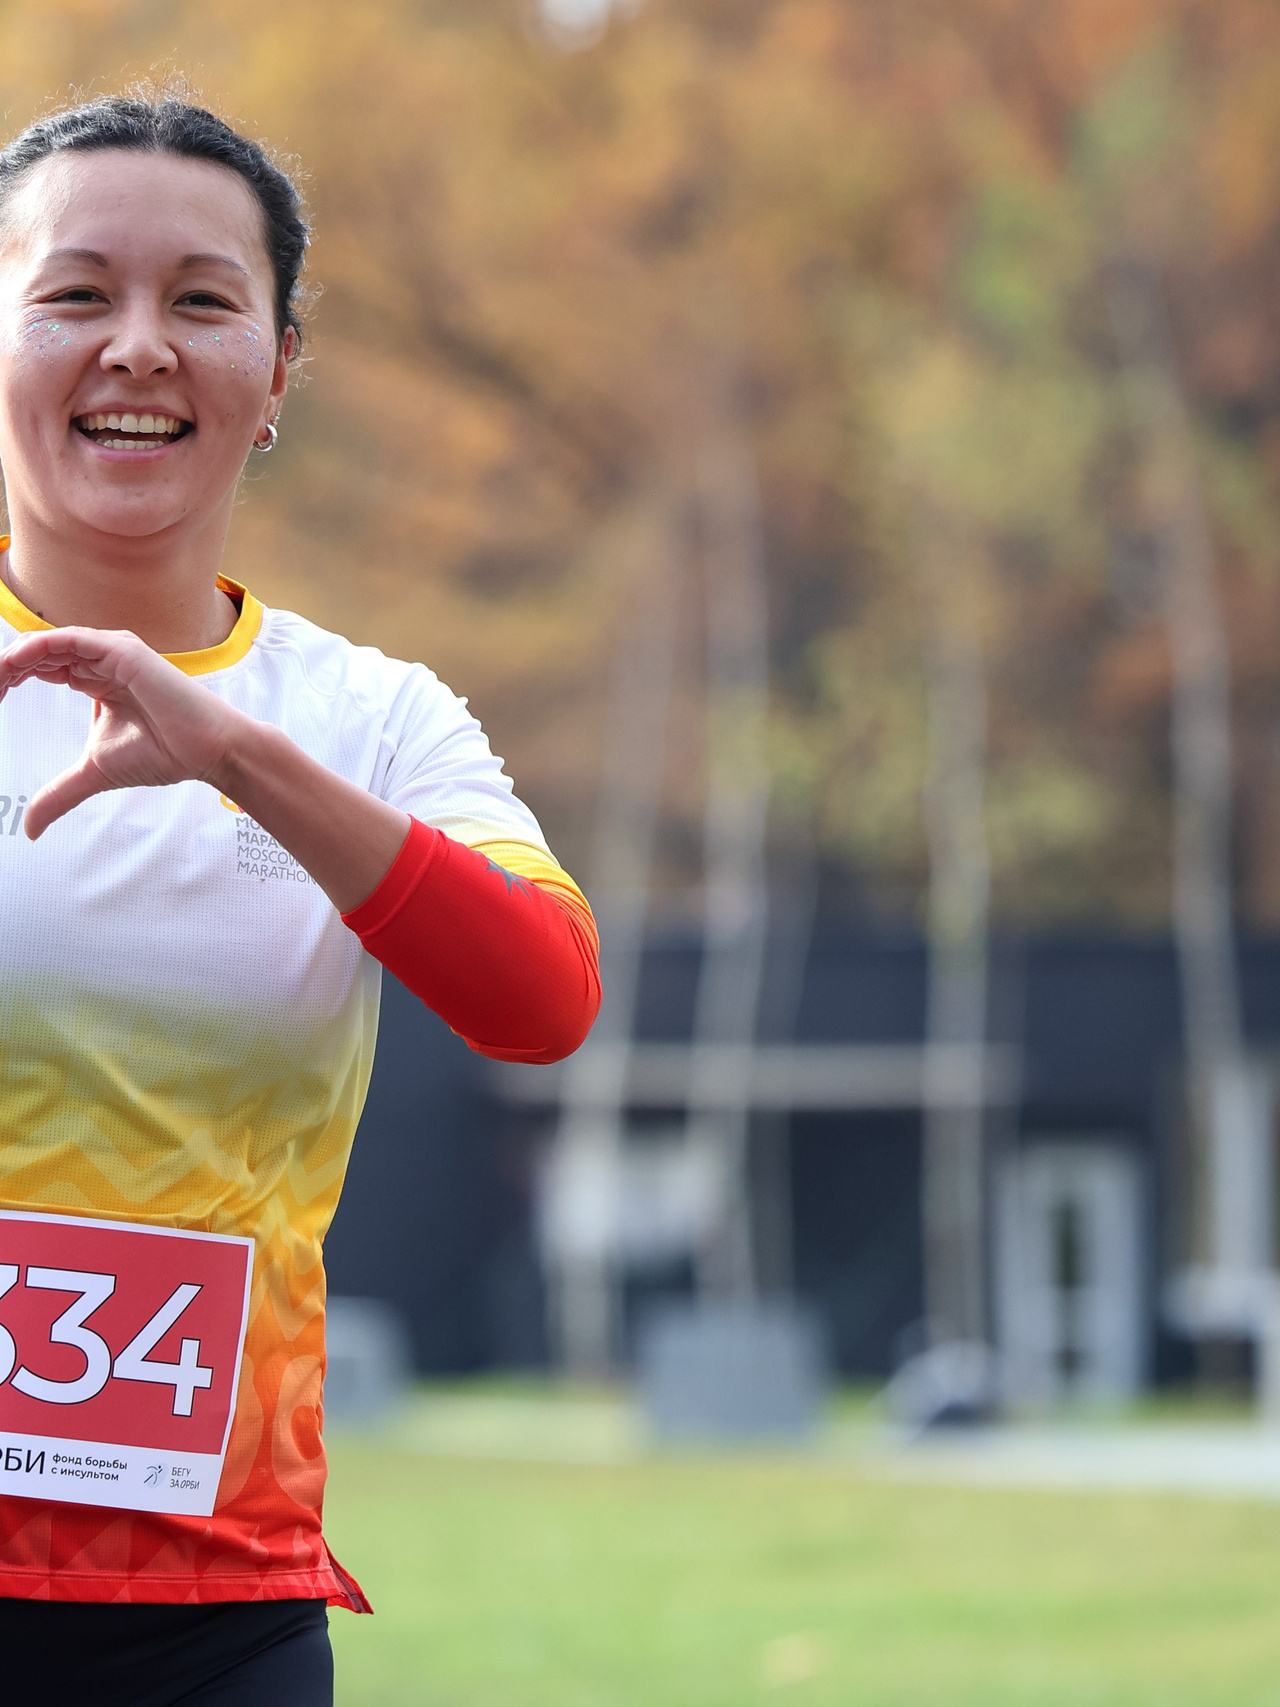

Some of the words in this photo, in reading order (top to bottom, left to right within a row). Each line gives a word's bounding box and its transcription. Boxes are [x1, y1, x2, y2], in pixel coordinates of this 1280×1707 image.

[52, 1453, 83, 1466] фонд
[85, 1456, 128, 1470] борьбы
[51, 1466, 58, 1475] с
[60, 1468, 119, 1482] инсультом
[171, 1466, 192, 1477] БЕГУ
